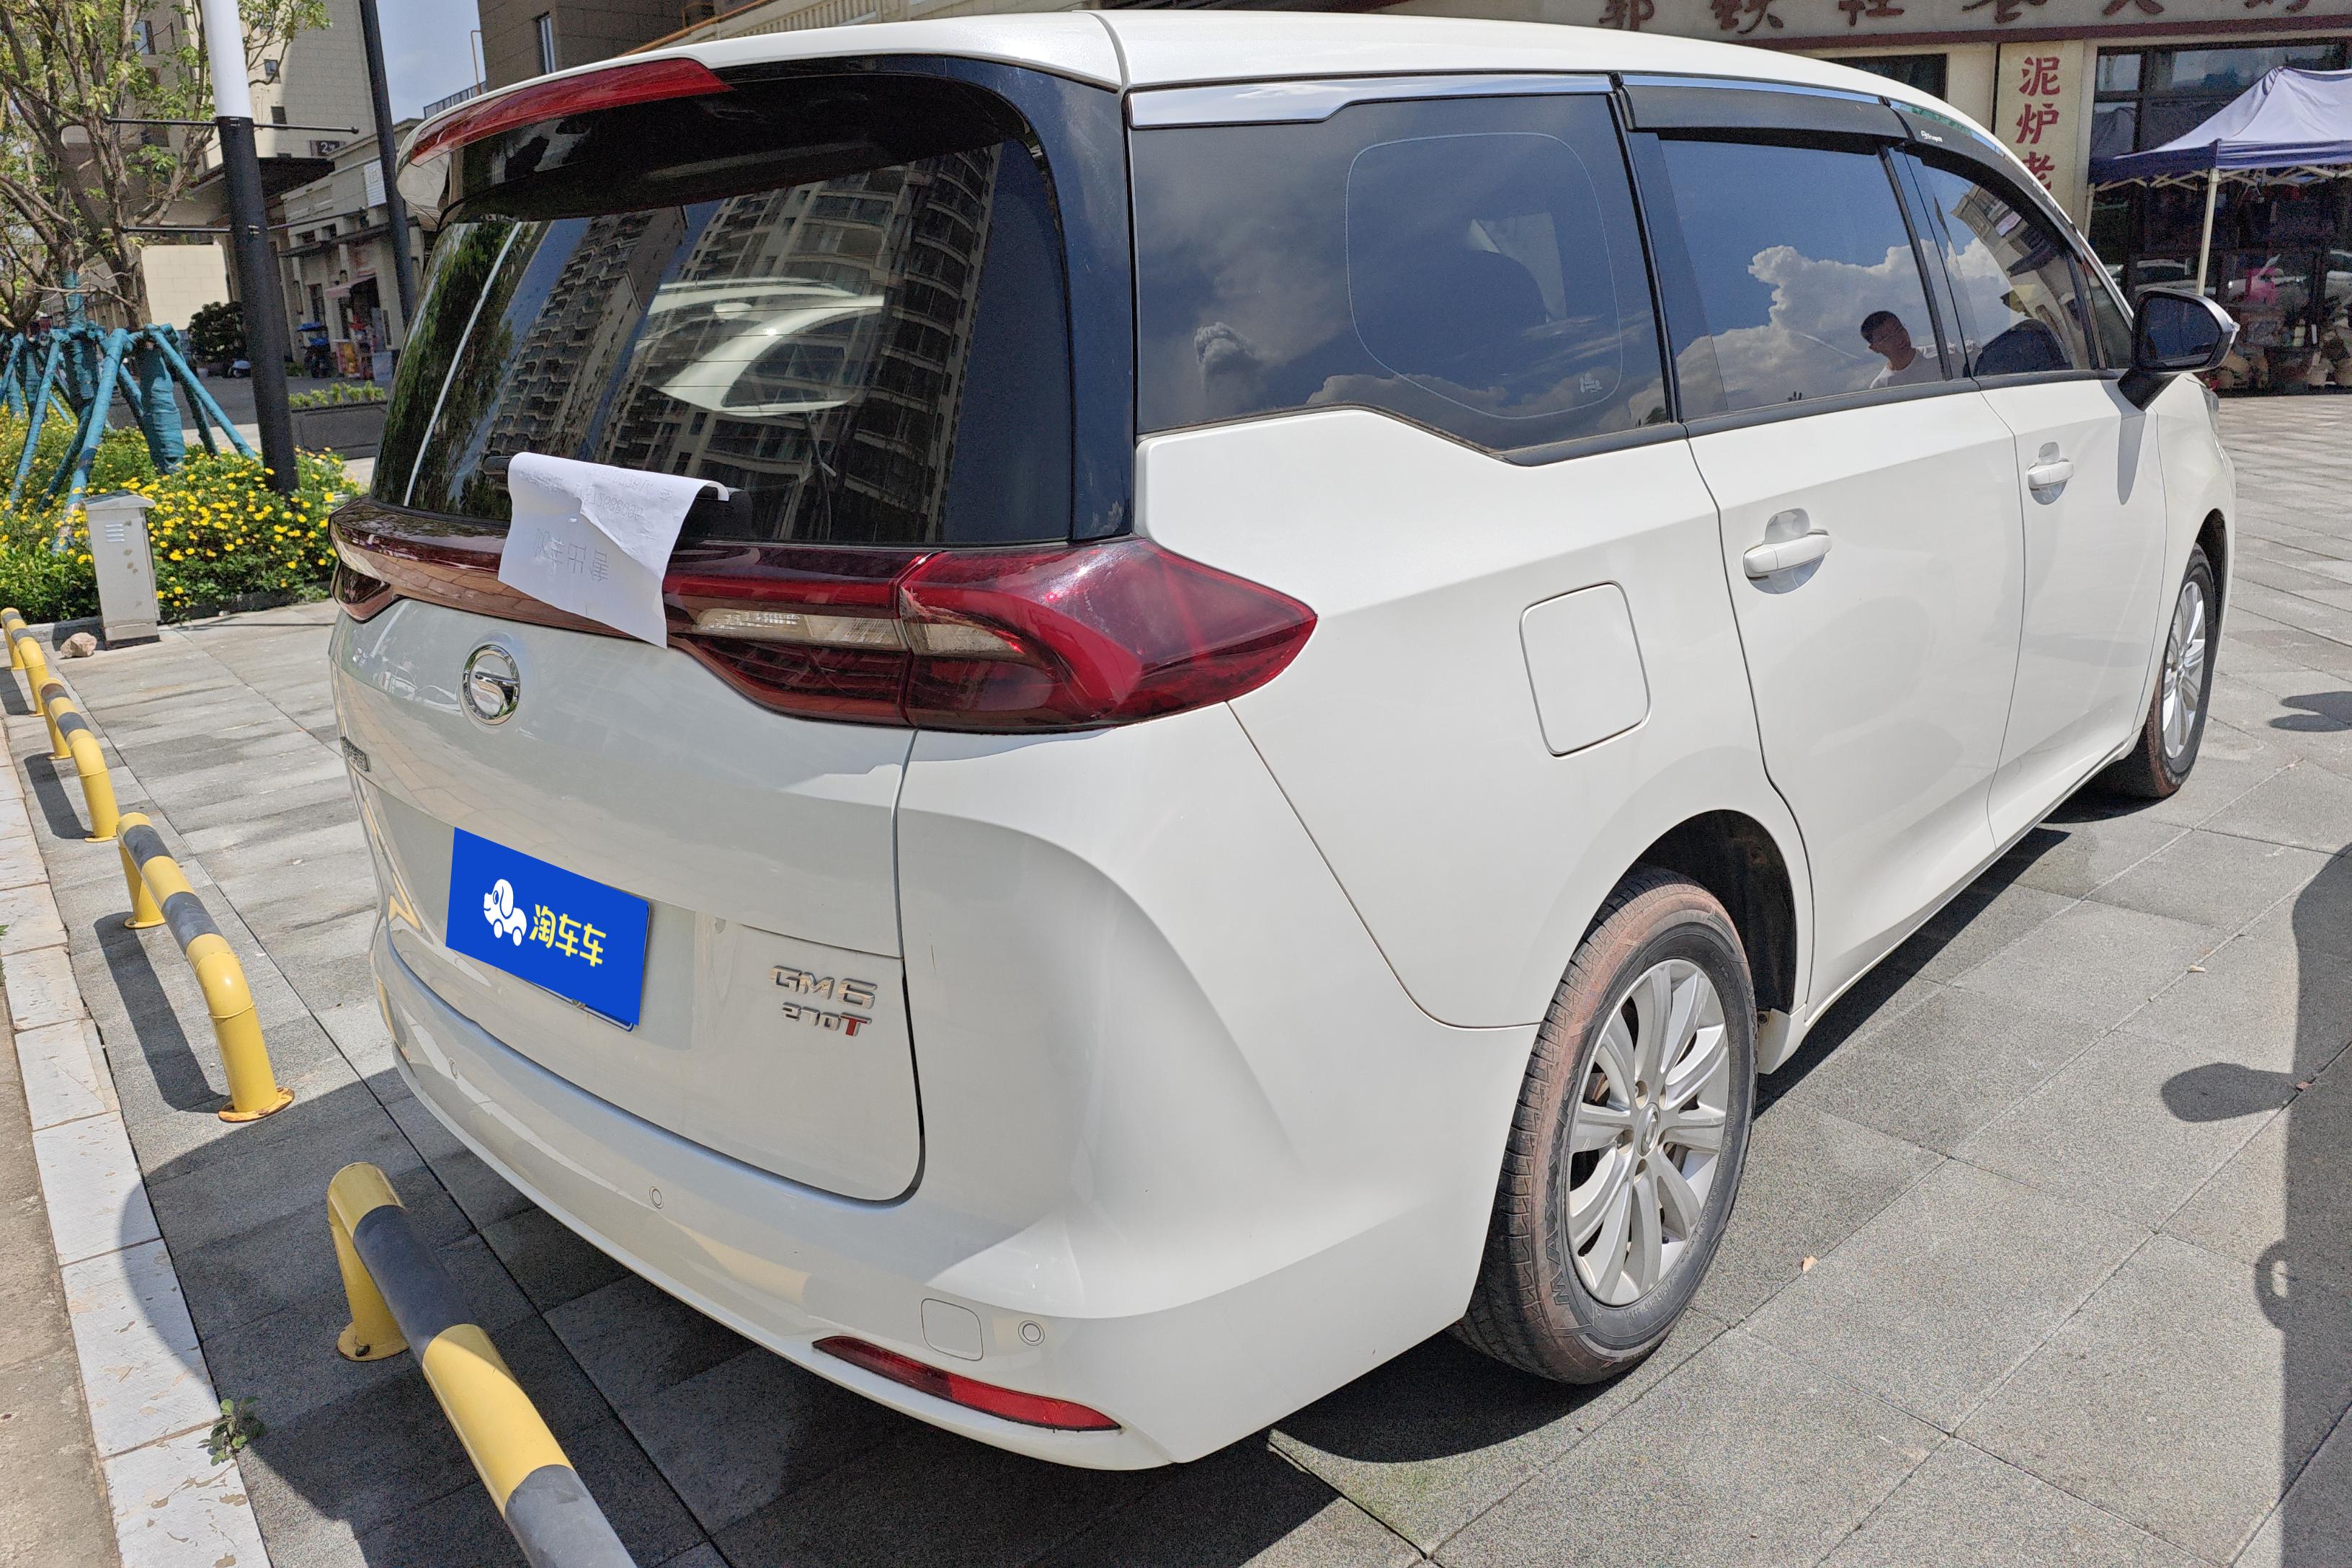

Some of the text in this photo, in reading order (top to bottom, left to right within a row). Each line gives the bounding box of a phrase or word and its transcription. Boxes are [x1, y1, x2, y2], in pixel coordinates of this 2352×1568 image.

[769, 965, 878, 1010] GM6
[780, 1002, 873, 1037] 270T
[1544, 1068, 1580, 1305] MAXXIS
